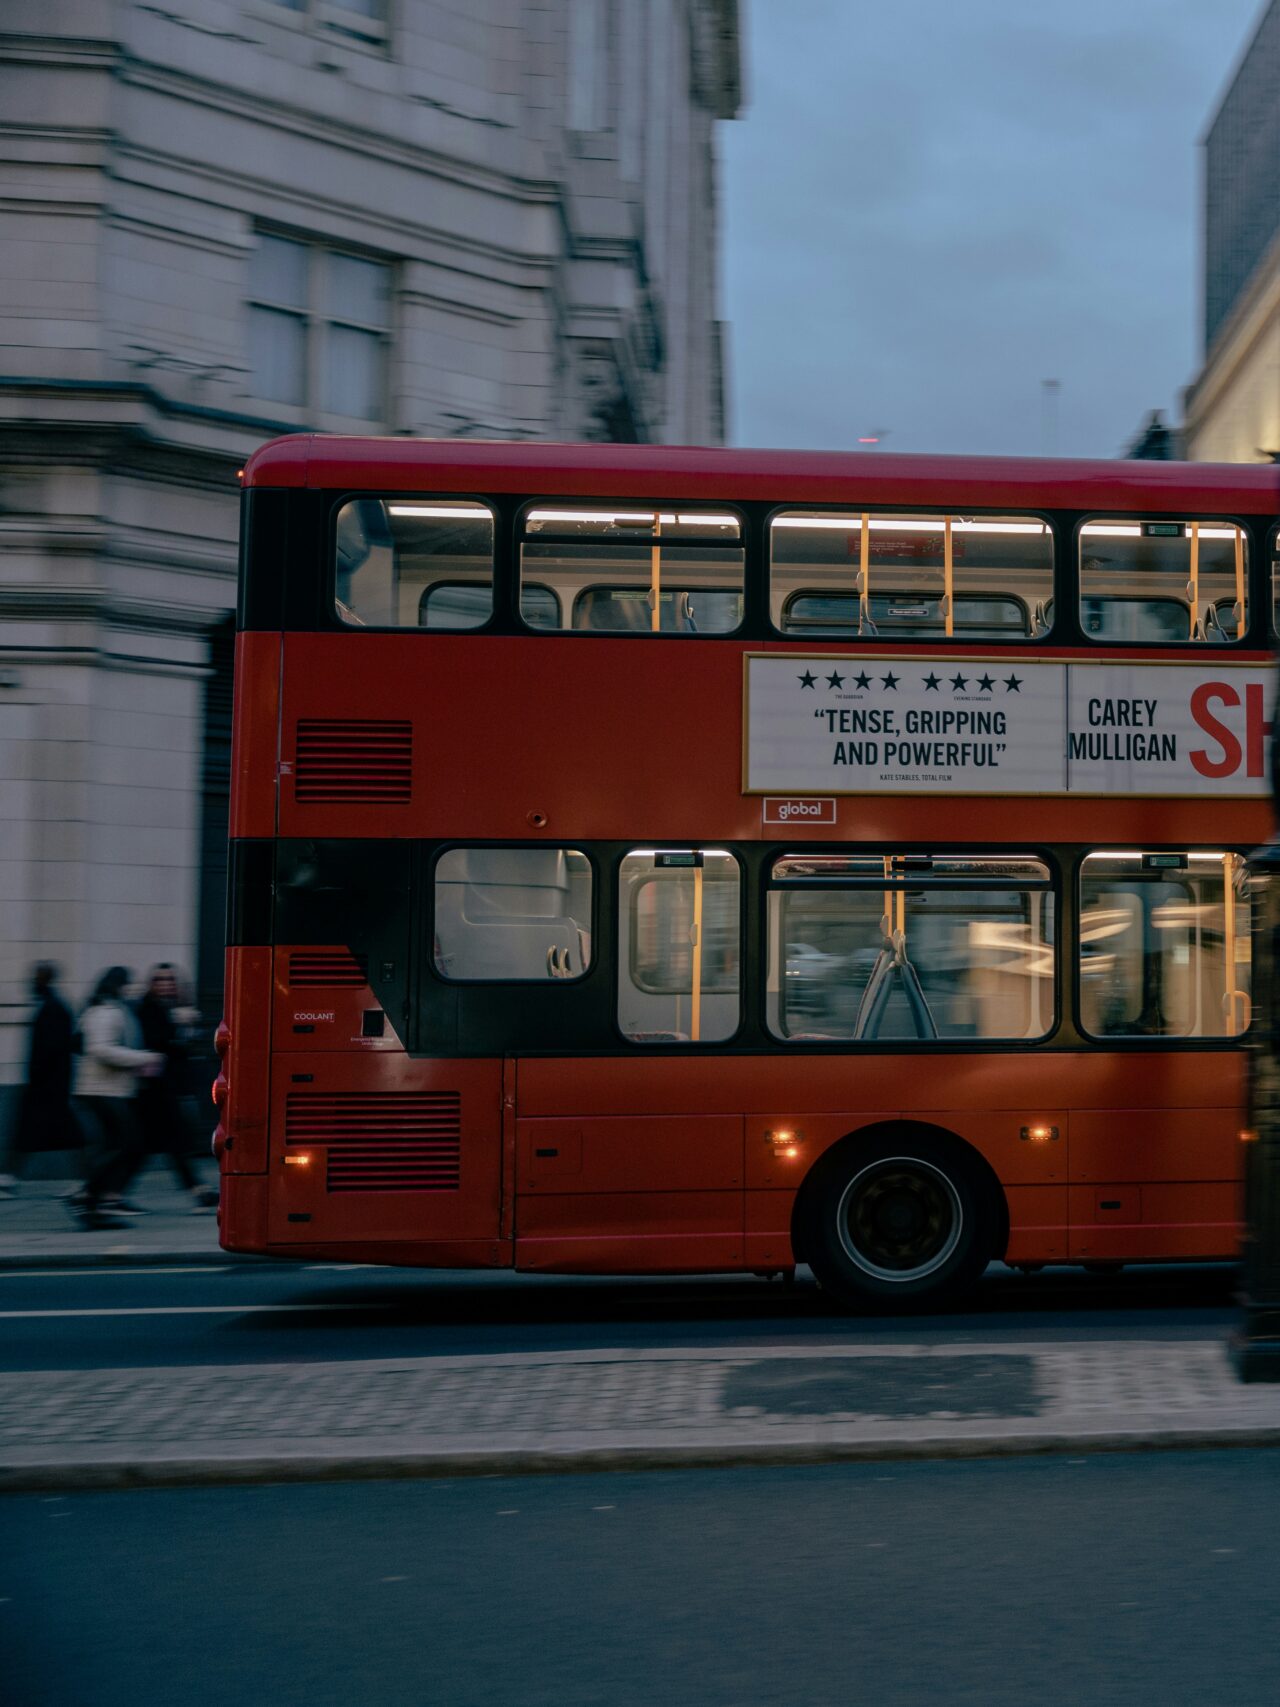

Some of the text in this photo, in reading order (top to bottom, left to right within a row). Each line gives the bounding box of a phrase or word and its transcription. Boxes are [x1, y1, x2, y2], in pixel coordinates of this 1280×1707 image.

[814, 709, 1006, 737] “TENSE, GRIPPING
[1088, 698, 1157, 727] CAREY
[833, 741, 1007, 766] AND POWERFUL”
[1068, 732, 1177, 761] MULLIGAN
[778, 803, 821, 817] global
